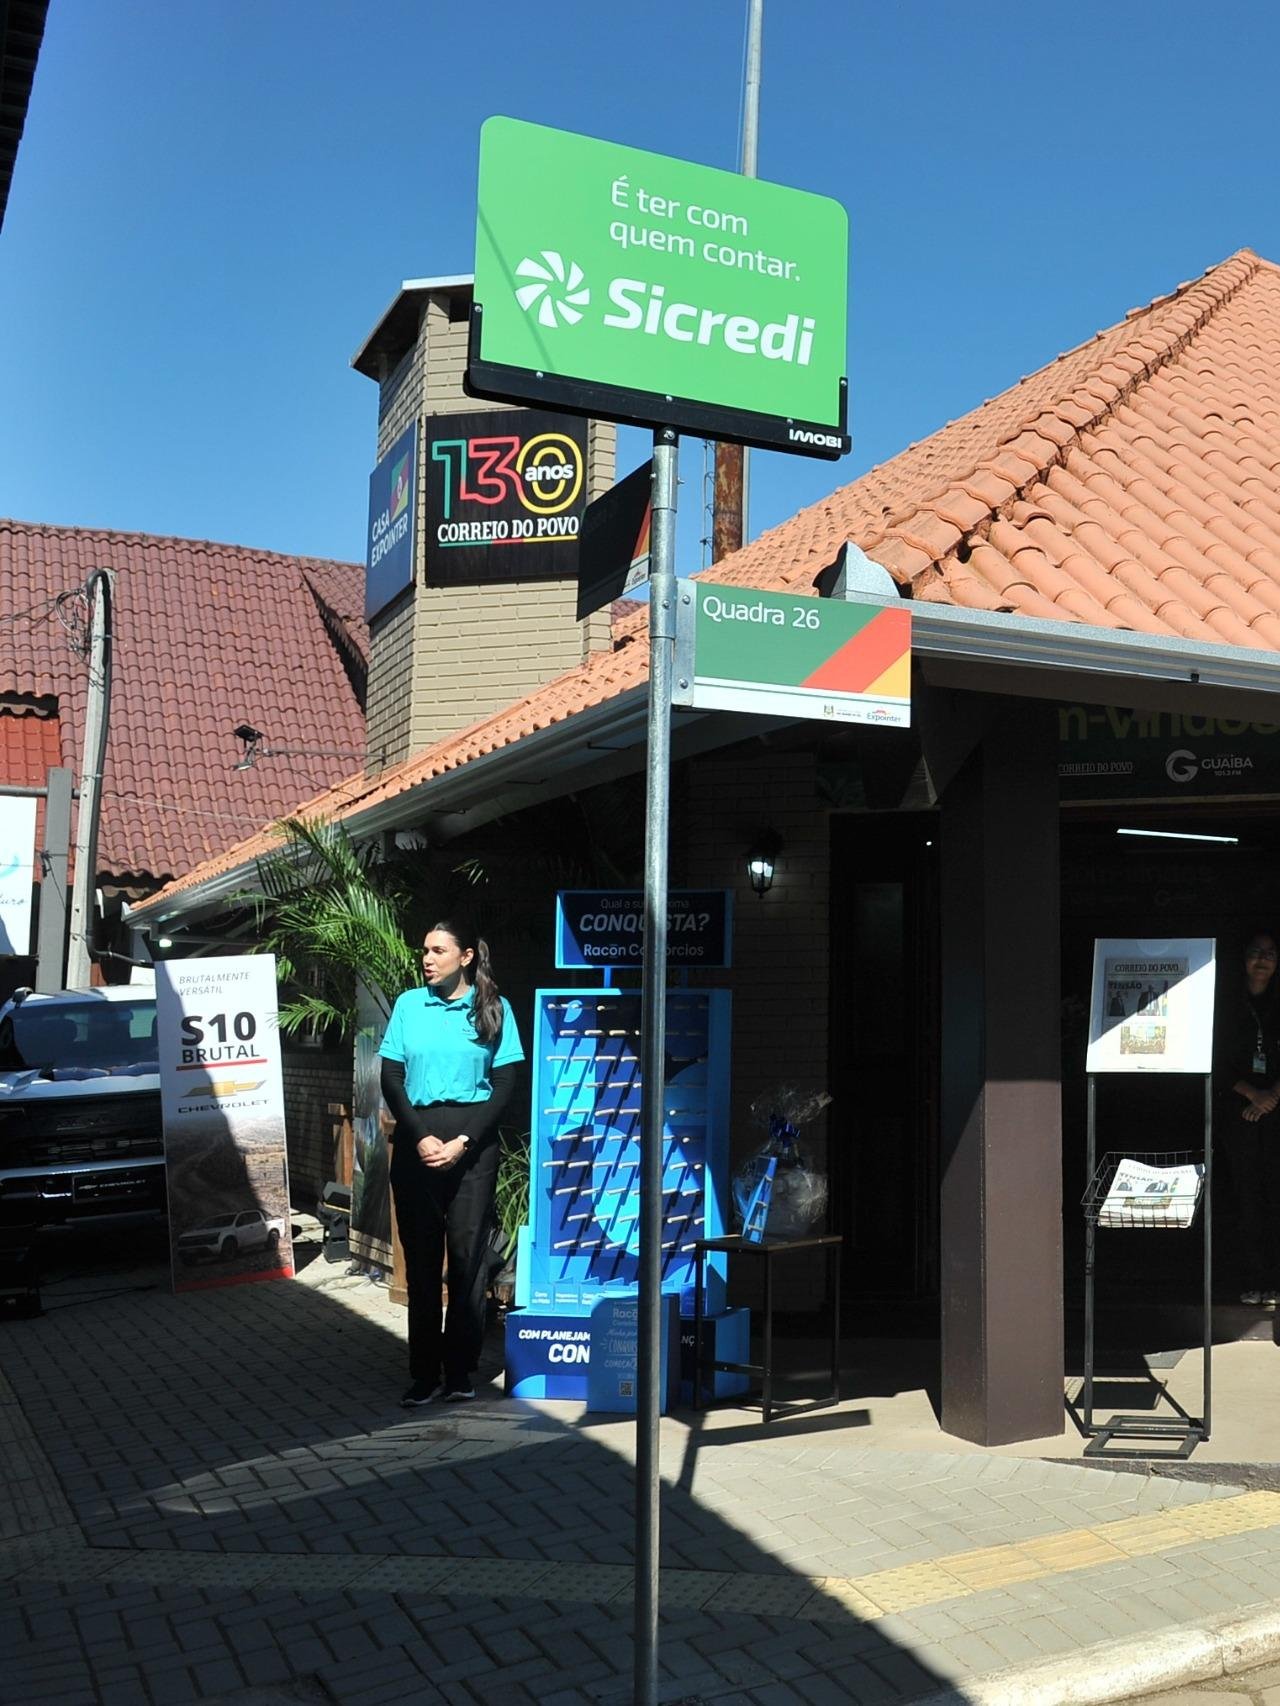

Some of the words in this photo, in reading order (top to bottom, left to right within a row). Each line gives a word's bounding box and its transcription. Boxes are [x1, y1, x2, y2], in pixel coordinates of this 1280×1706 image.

[610, 175, 630, 208] É
[636, 192, 681, 219] ter
[686, 205, 748, 236] com
[609, 220, 696, 258] quem
[702, 240, 801, 282] contar.
[603, 276, 816, 367] Sicredi
[788, 429, 842, 449] IMOBI
[431, 432, 583, 520] 130
[524, 463, 574, 482] anos
[372, 508, 390, 542] CASA
[437, 520, 509, 543] CORREIO
[512, 519, 534, 538] DO
[536, 516, 579, 537] POVO
[371, 513, 408, 568] EXPOINTER
[702, 596, 785, 626] Quadra
[791, 607, 821, 630] 26
[579, 913, 711, 933] CONQTA?
[628, 944, 705, 958] Corcios
[179, 971, 251, 985] BRUTALMENTE
[180, 1011, 256, 1047] S10
[182, 1044, 260, 1064] BRUTAL
[178, 1099, 270, 1114] CHEVROLET
[518, 1329, 541, 1341] COM
[540, 1330, 591, 1342] PLANEJAM
[548, 1343, 591, 1365] CON
